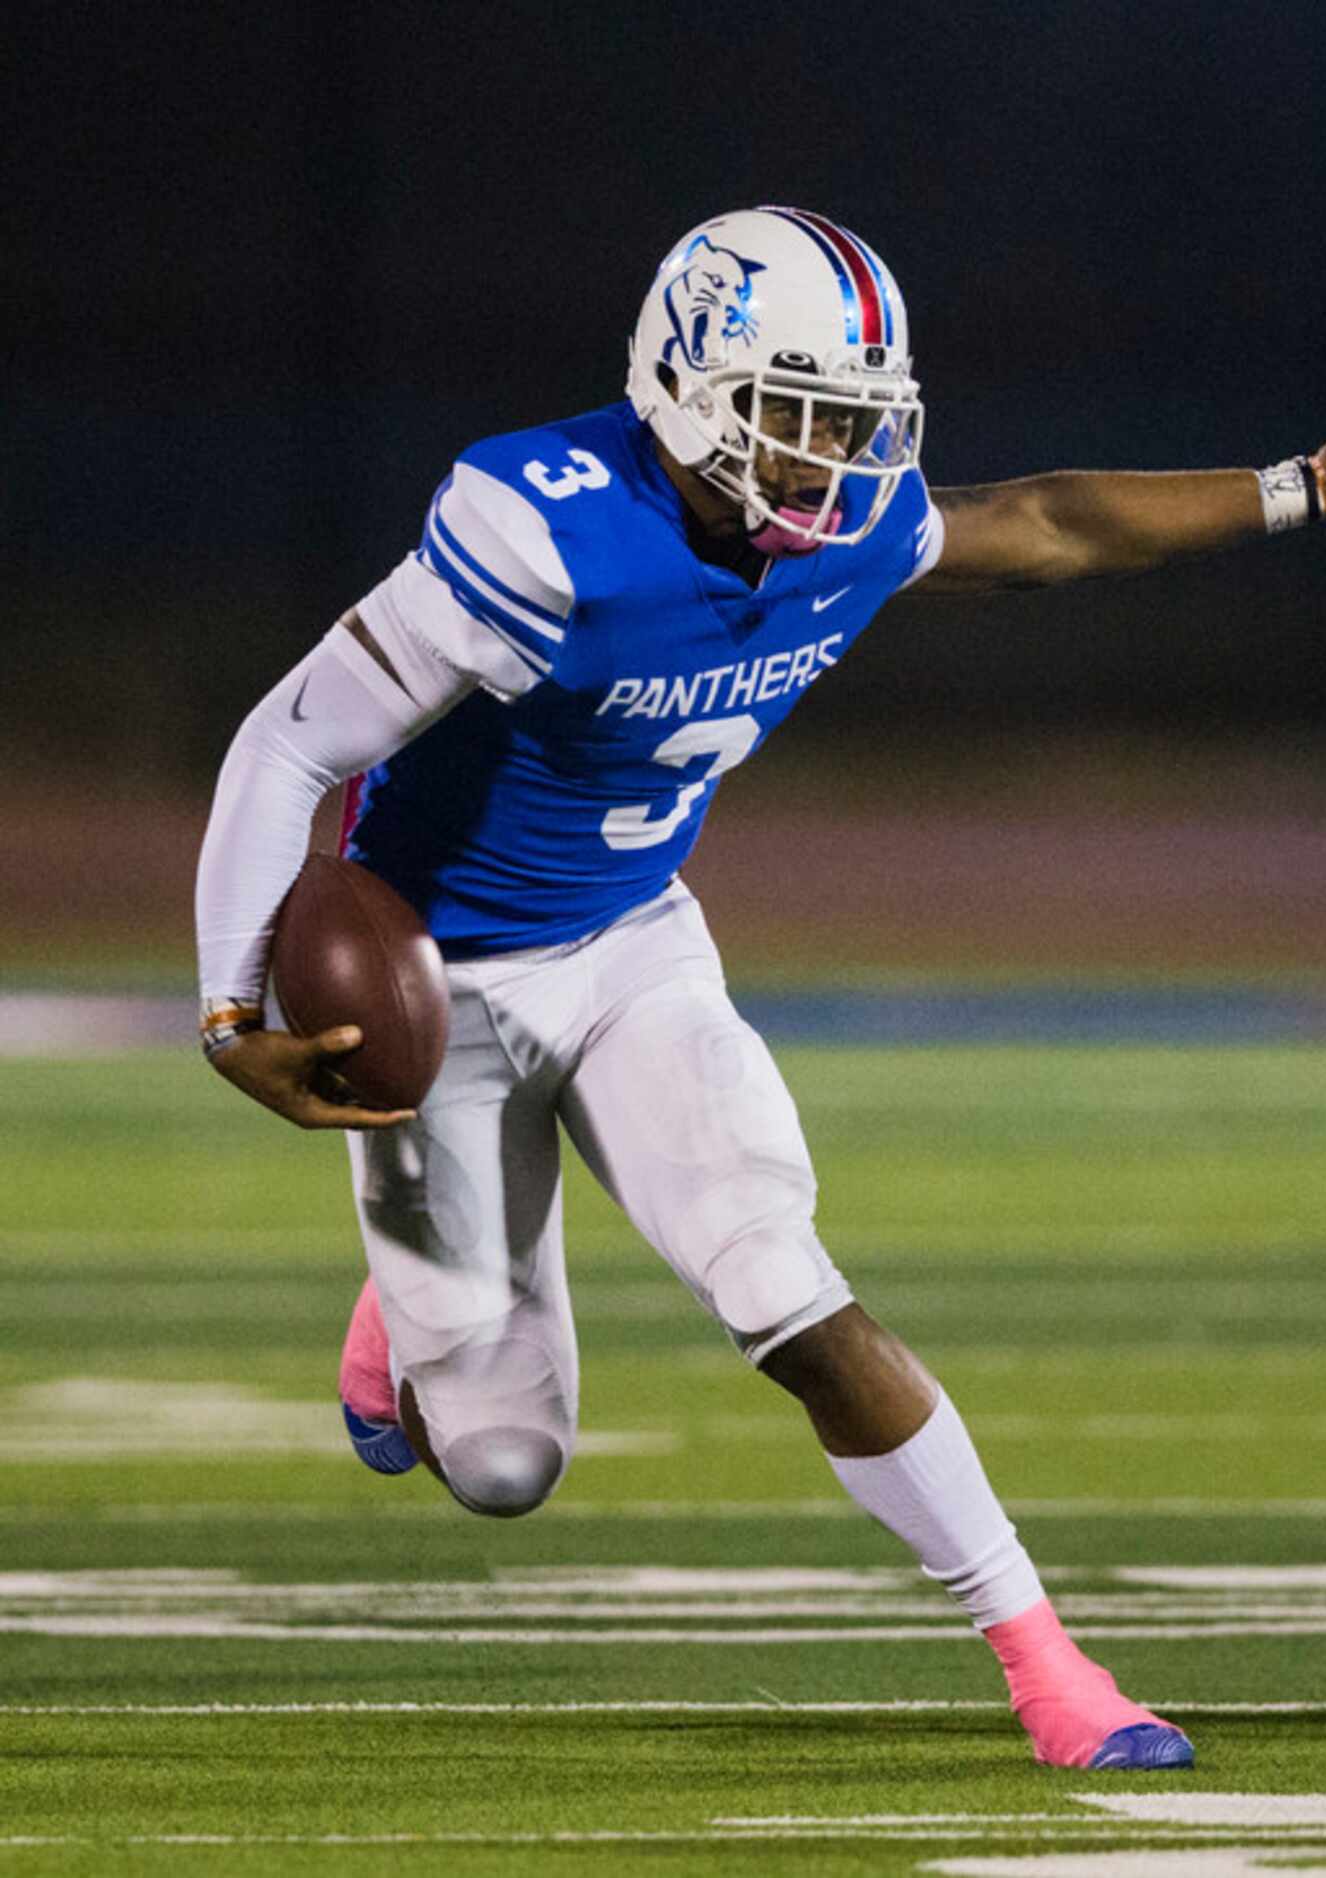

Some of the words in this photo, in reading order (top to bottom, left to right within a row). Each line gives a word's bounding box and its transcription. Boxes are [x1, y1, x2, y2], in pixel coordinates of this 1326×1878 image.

[523, 448, 611, 500] 3
[594, 631, 844, 719] PANTHERS
[600, 713, 762, 851] 3
